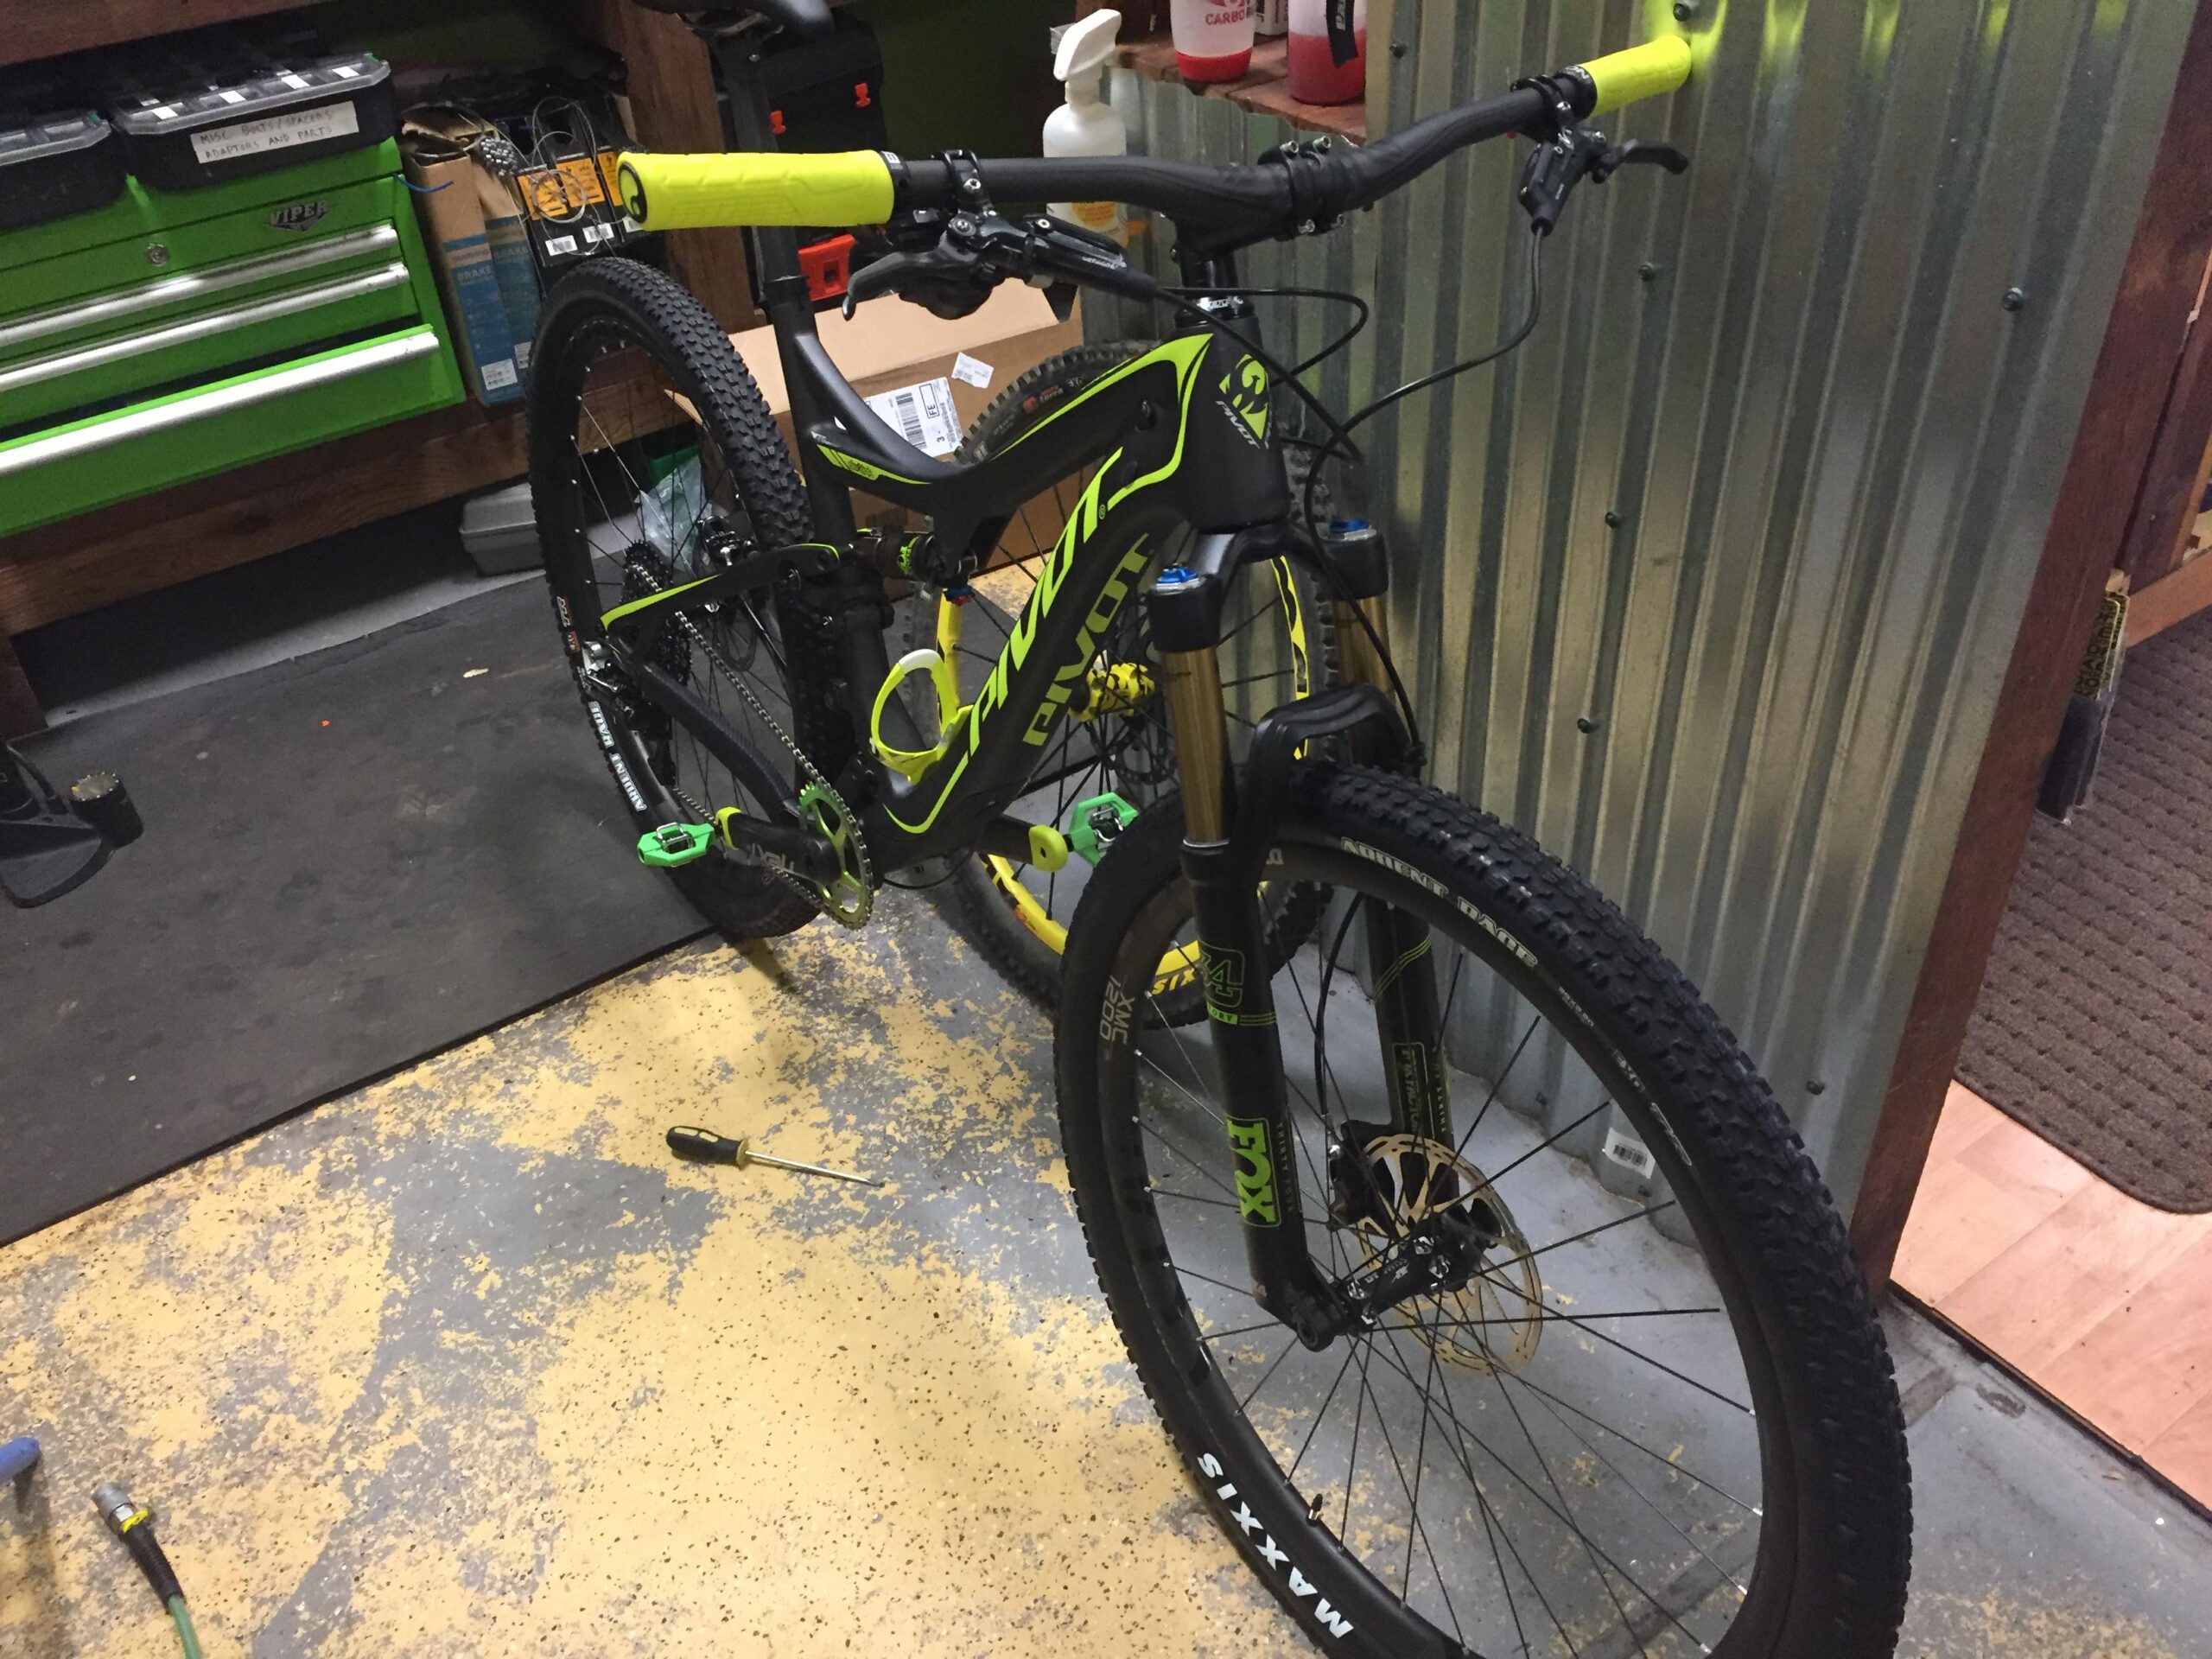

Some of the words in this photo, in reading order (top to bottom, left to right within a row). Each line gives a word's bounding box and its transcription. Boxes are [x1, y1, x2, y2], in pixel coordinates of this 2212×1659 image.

[200, 130, 232, 145] MISC
[205, 141, 259, 159] ADAPTORS
[269, 133, 290, 147] AND
[298, 125, 334, 141] PARTS
[270, 200, 332, 226] VIPER
[927, 404, 938, 416] FE
[1215, 400, 1262, 449] PIVOT
[969, 446, 1123, 758] PIVOT
[1023, 532, 1154, 747] PIVOT
[609, 753, 647, 812] ARDENT
[1340, 836, 1450, 899] ARDENT
[1099, 974, 1122, 1041] 1200
[1111, 991, 1136, 1046] XMC
[1227, 1119, 1276, 1224] FOX
[1276, 1122, 1289, 1170] THIRTY
[1197, 1452, 1355, 1639] MAXXIS
